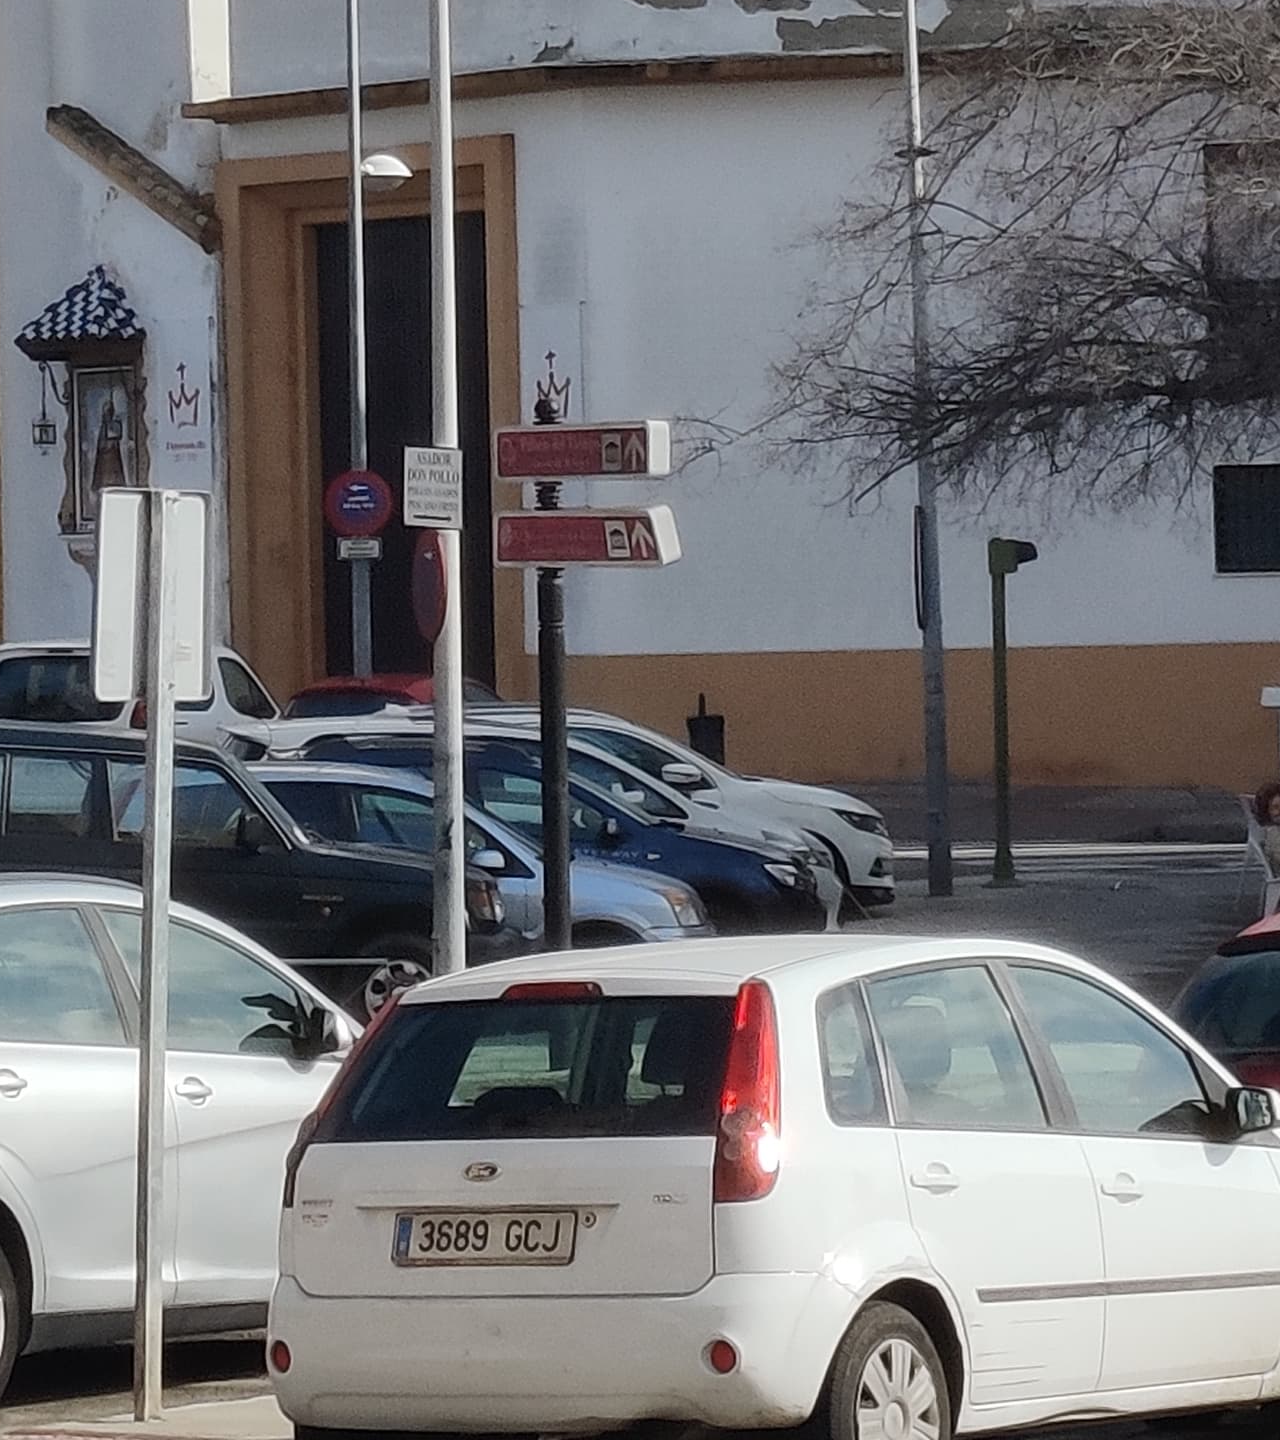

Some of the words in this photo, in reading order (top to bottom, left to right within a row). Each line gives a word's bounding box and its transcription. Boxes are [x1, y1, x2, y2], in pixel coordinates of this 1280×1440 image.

[408, 468, 426, 481] DON
[429, 469, 459, 484] POLLO
[418, 1219, 489, 1253] 3689
[505, 1219, 561, 1253] GCJ
